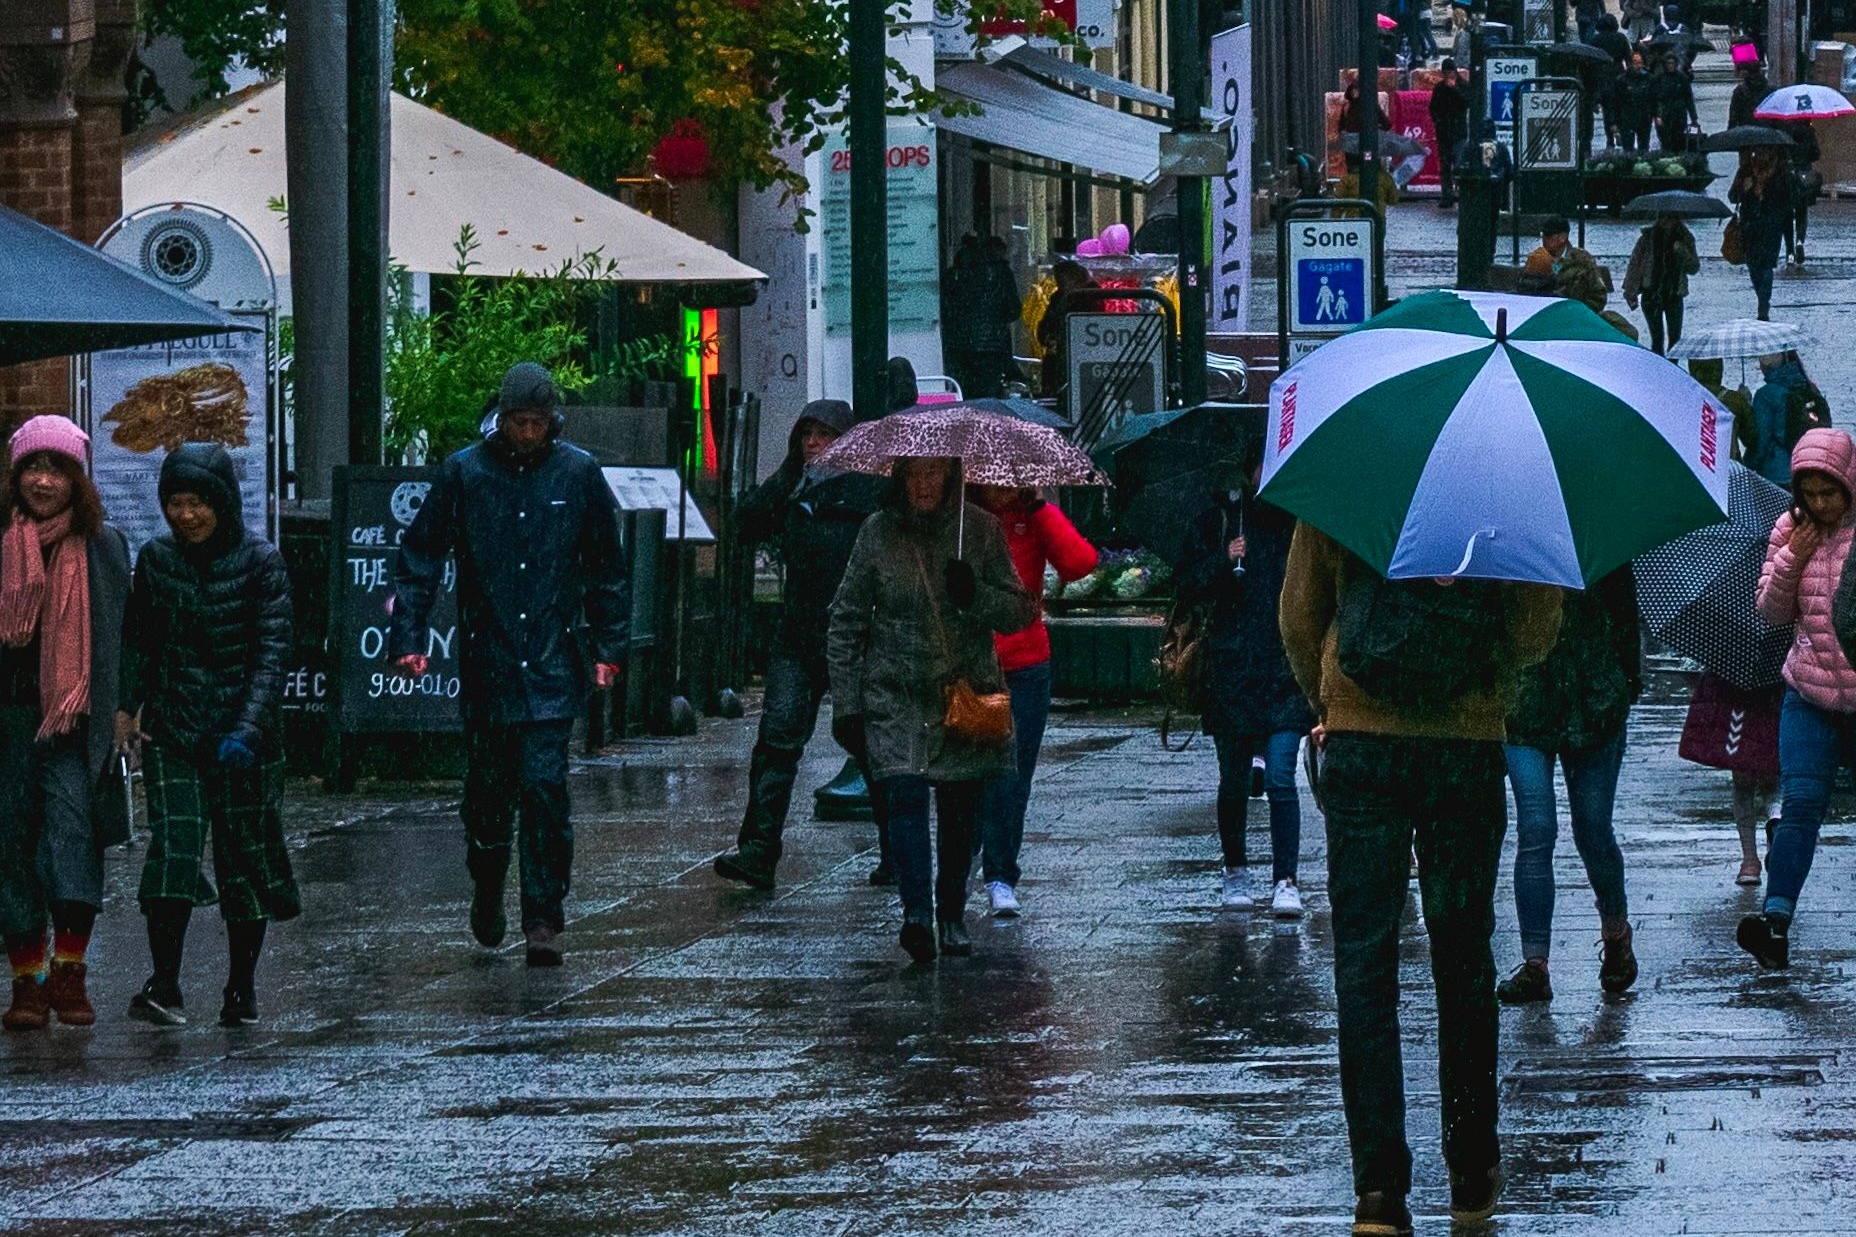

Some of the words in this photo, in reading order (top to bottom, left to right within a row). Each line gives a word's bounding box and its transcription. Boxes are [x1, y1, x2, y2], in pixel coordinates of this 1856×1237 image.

[1494, 62, 1529, 76] Sone
[1303, 227, 1359, 247] Sone
[351, 525, 387, 545] CAFÉ
[347, 558, 388, 593] THE
[360, 625, 456, 660] ON
[368, 672, 461, 699] 9:00-01:0
